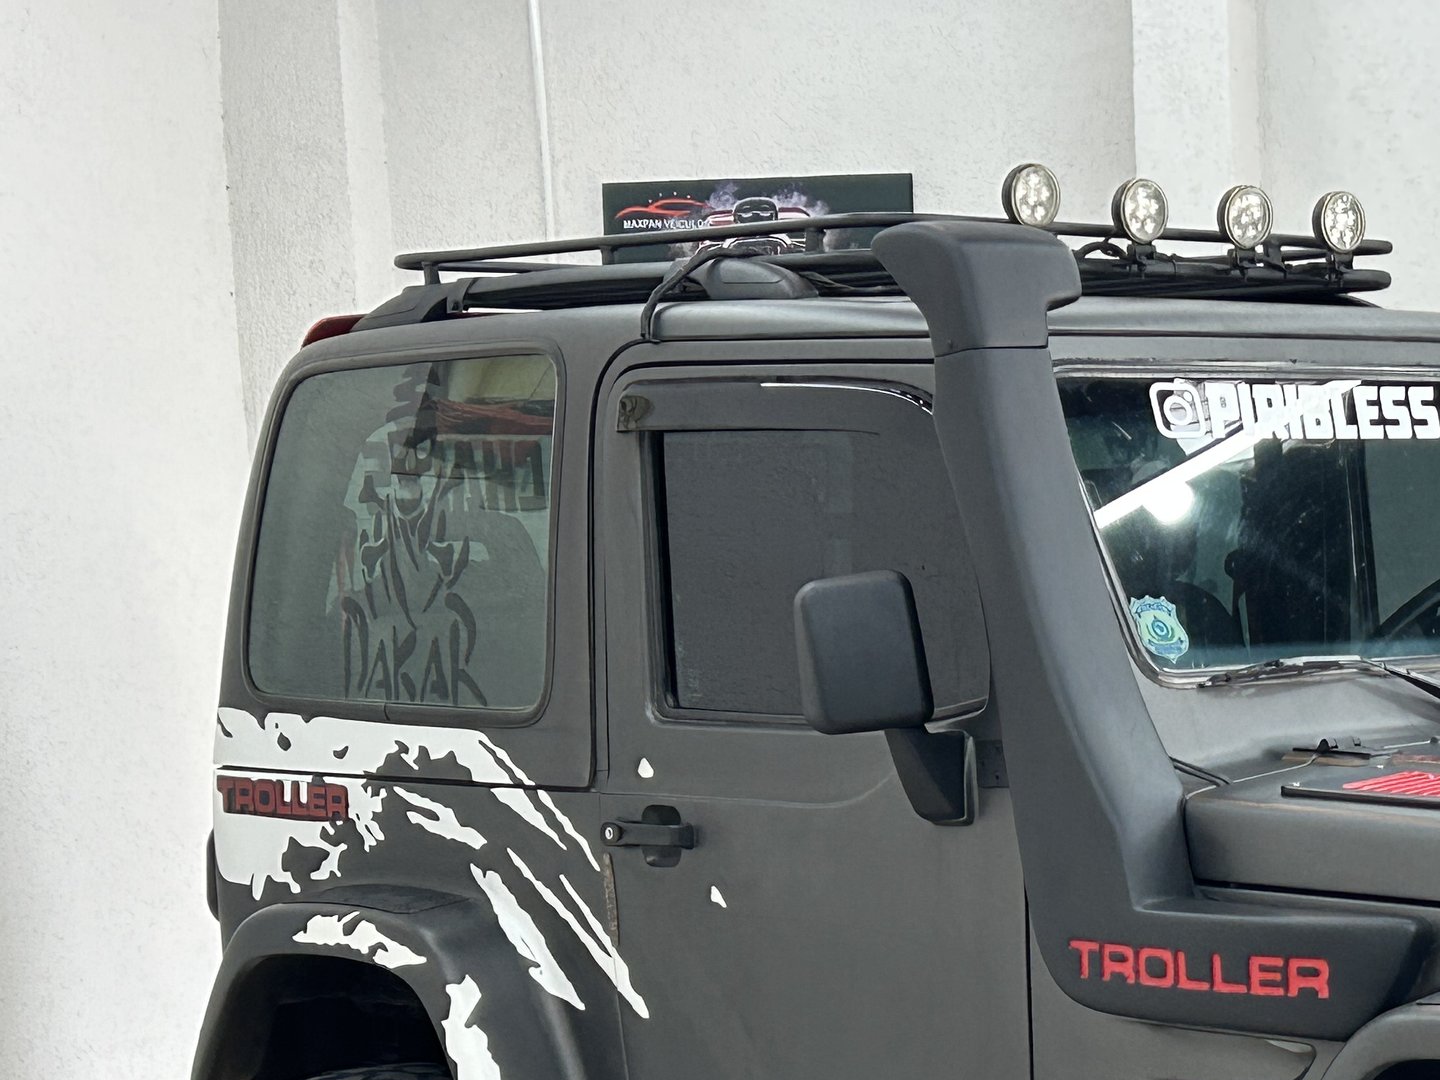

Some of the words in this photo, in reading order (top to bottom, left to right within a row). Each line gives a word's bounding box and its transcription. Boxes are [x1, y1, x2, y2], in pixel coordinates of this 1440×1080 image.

[341, 592, 487, 706] DAKAR
[217, 775, 349, 822] TROLLER
[1069, 939, 1329, 999] TROLLER
